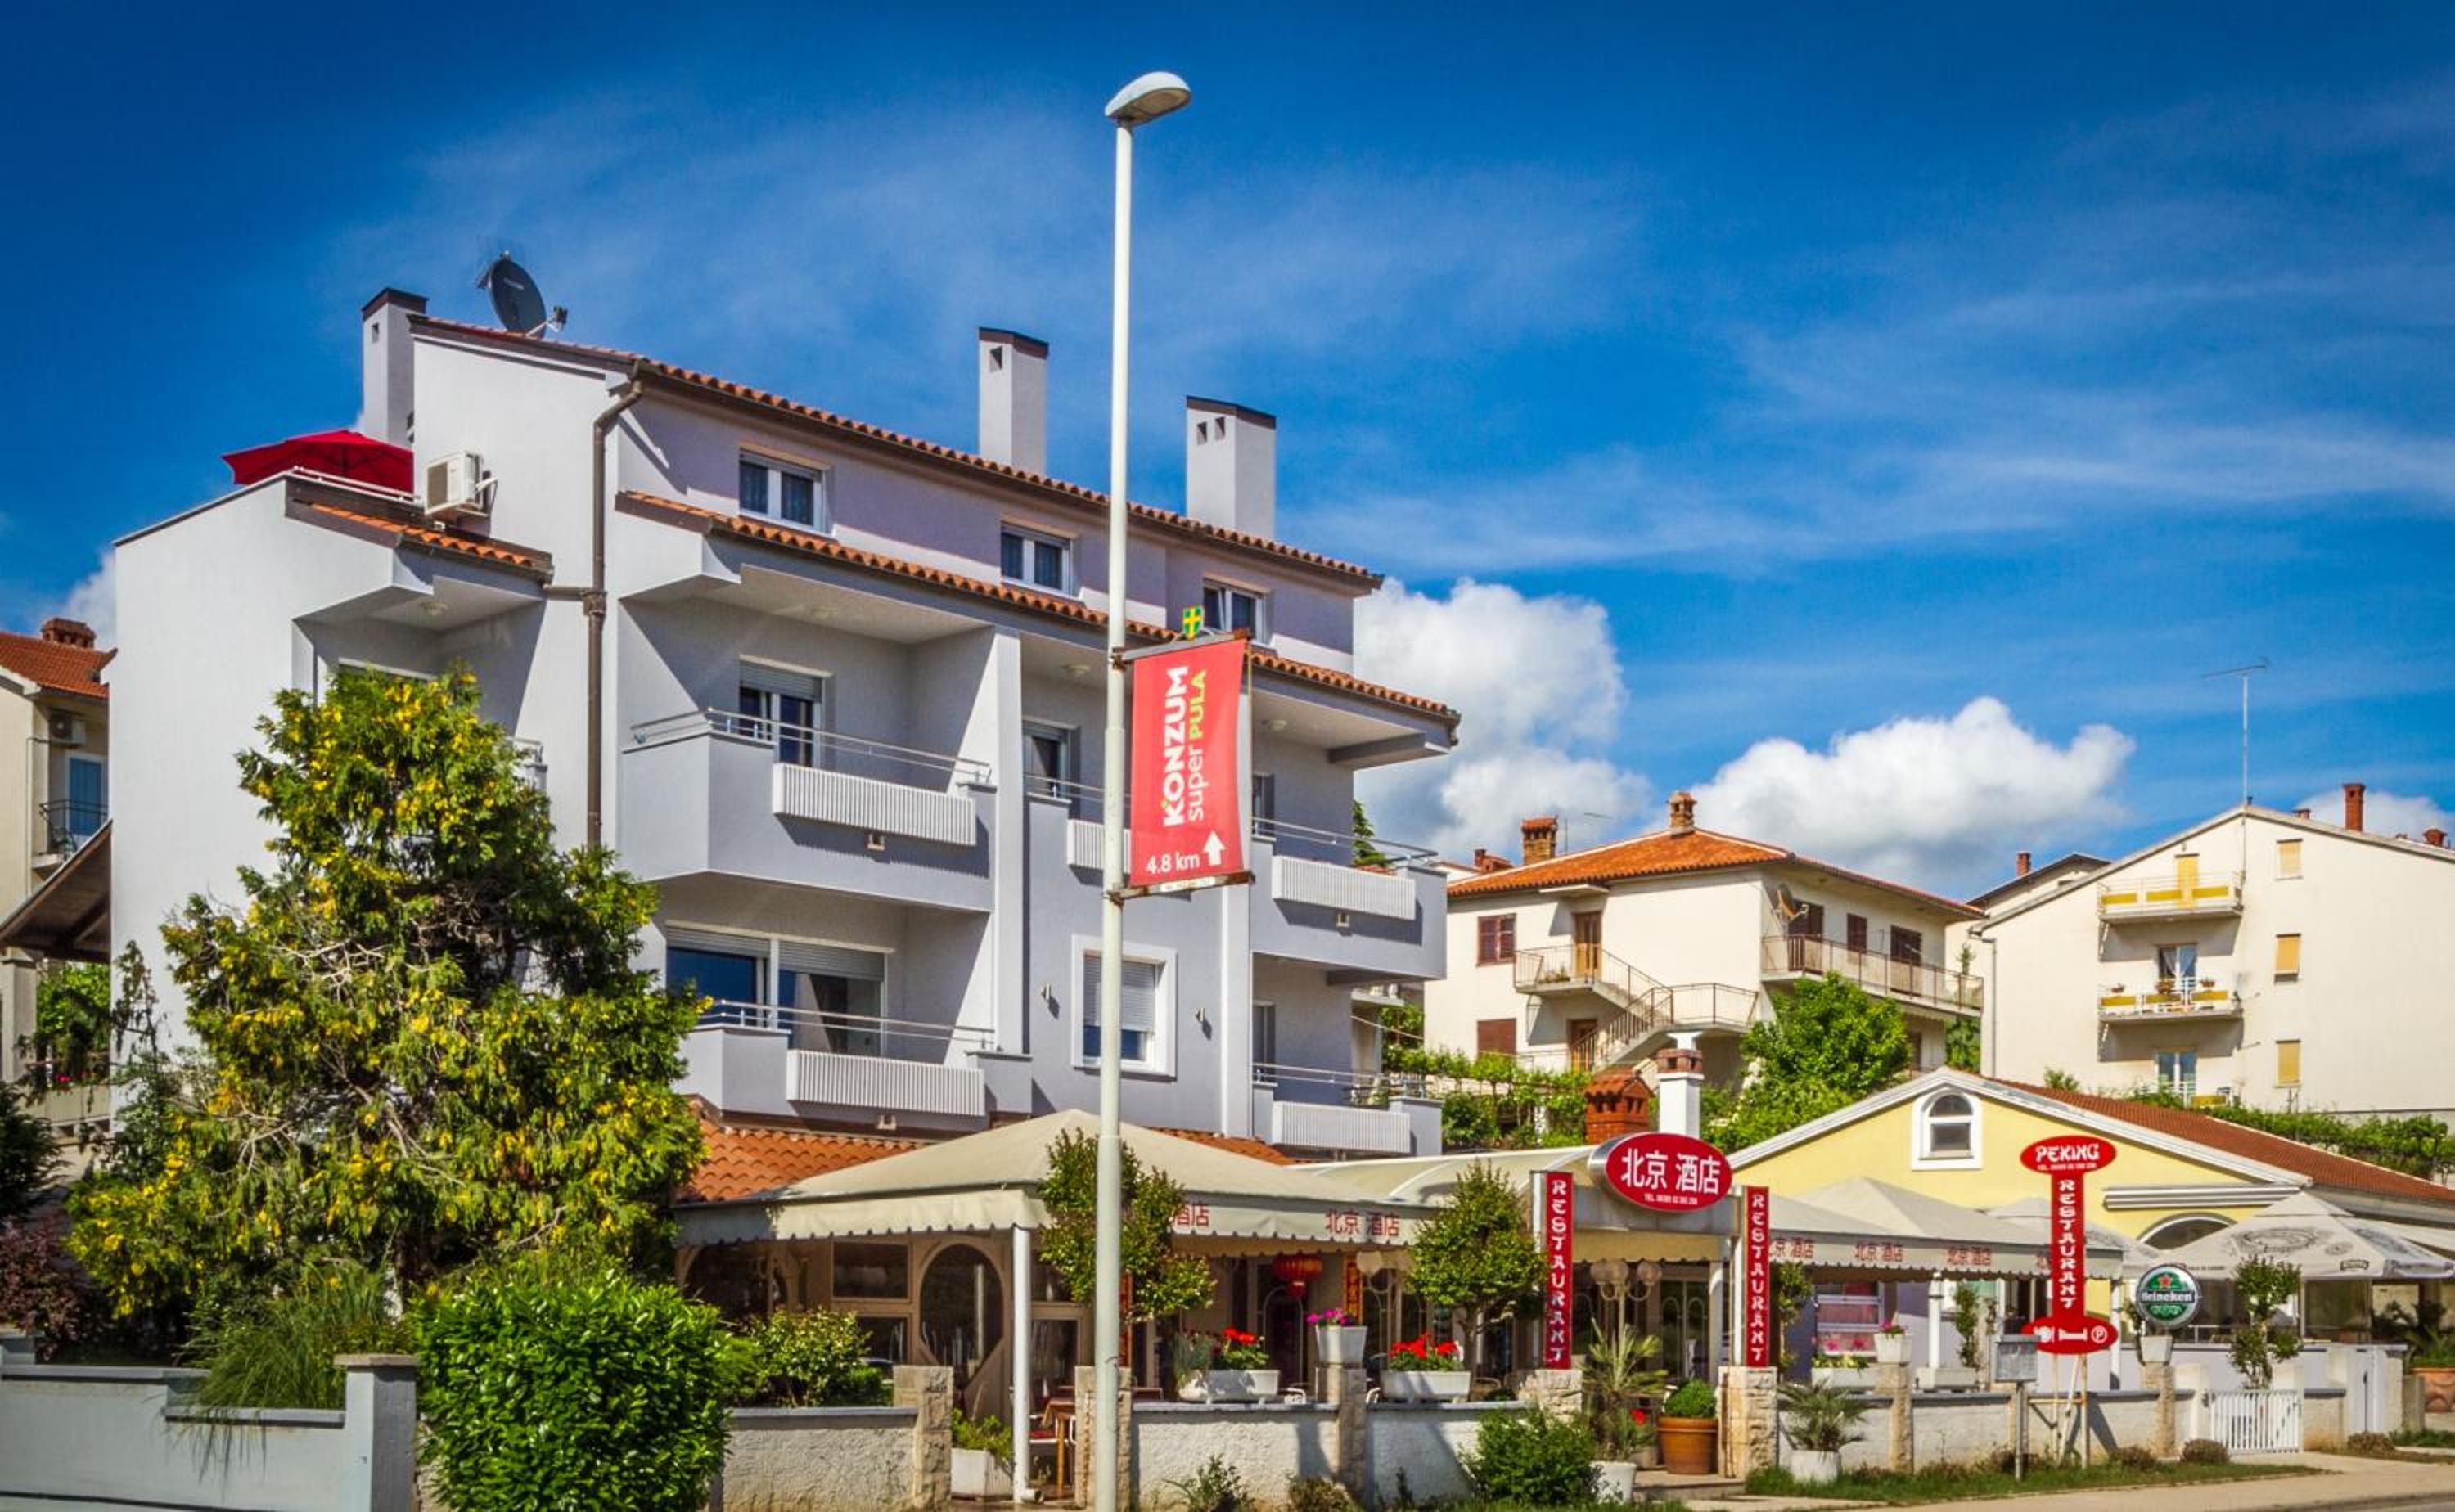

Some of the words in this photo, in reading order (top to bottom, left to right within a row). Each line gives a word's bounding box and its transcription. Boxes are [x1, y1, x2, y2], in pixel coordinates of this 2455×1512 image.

[1188, 669, 1207, 740] PULA
[1161, 665, 1189, 826] KONZUM
[1187, 746, 1209, 821] super
[1146, 853, 1172, 874] 4.8
[1175, 851, 1200, 870] km
[1620, 1147, 1668, 1190] 北京
[1676, 1153, 1721, 1195] 酒店
[2035, 1143, 2100, 1162] PEKING
[1324, 1208, 1359, 1235] 北京
[1366, 1211, 1400, 1237] 酒店
[2058, 1179, 2077, 1309] RESTAURANT
[1548, 1179, 1567, 1363] RESTAURANT
[1750, 1194, 1765, 1361] RESTAURANT
[2142, 1292, 2192, 1303] Heineken
